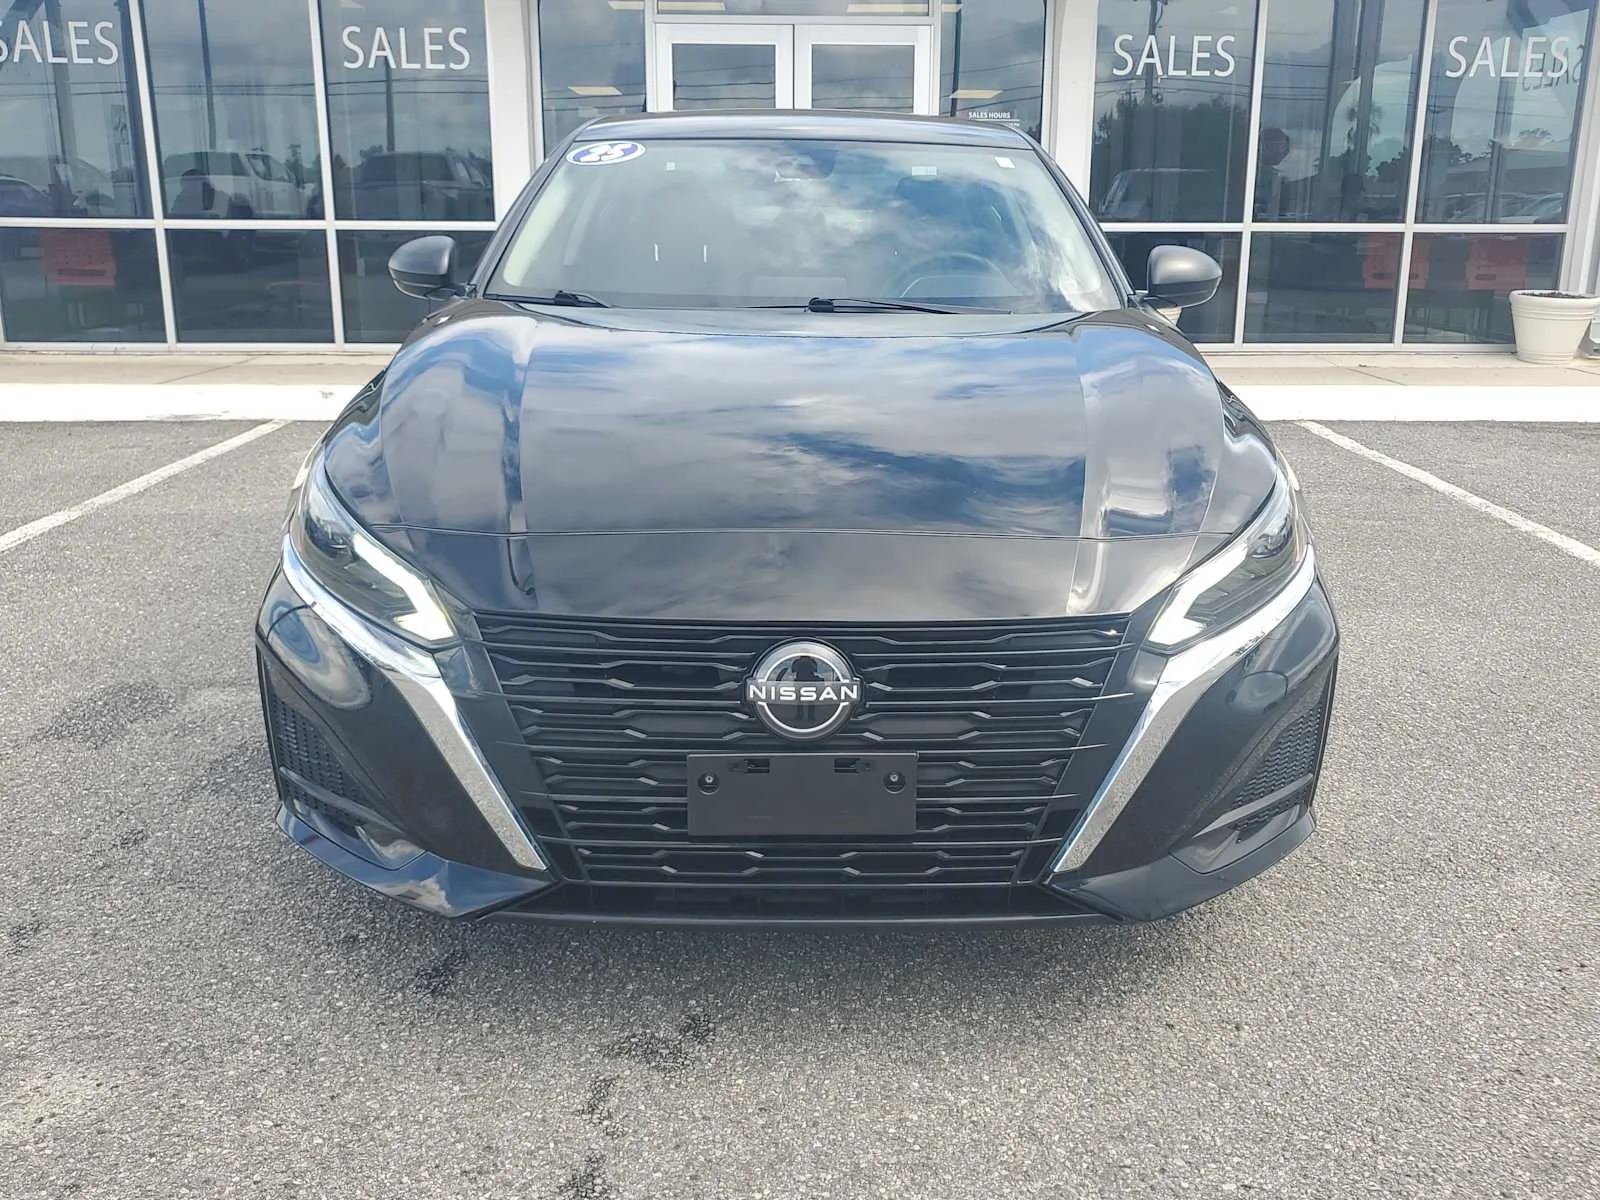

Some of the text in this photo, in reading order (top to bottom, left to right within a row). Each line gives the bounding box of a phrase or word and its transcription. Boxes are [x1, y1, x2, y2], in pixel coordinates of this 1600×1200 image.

[342, 25, 471, 70] SALES
[1112, 33, 1236, 77] SALES
[1445, 35, 1570, 78] SALES
[968, 111, 1011, 119] SALES HOURS
[579, 143, 634, 163] 25
[749, 684, 858, 701] NISSAN
